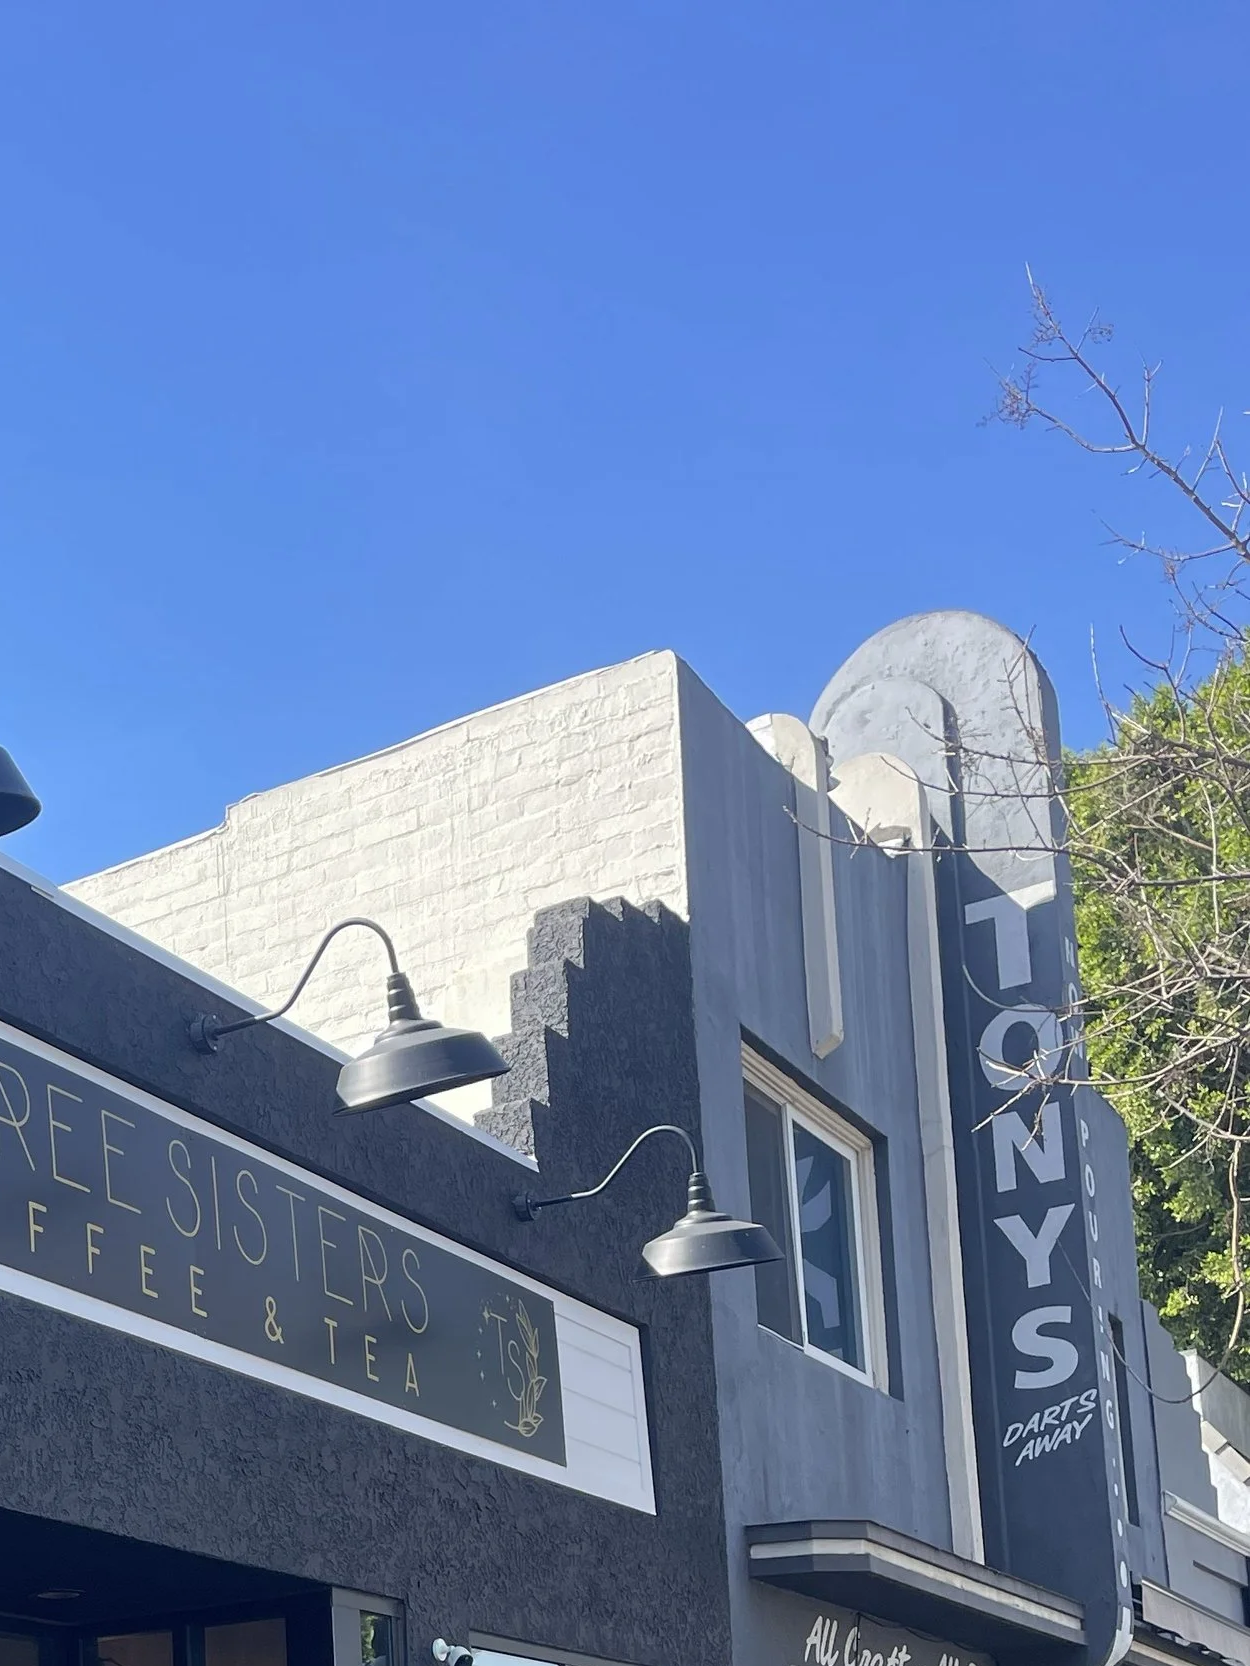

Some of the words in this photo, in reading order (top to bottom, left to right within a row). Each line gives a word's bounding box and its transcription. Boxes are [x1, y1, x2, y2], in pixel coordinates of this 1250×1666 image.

[964, 896, 1080, 1390] TONYS
[166, 1139, 430, 1334] SISTERS
[1080, 1119, 1115, 1429] POURING
[264, 1296, 285, 1344] &
[324, 1317, 421, 1398] TEA
[489, 1312, 526, 1401] TS
[1003, 1388, 1098, 1448] DARTS
[1014, 1413, 1093, 1467] AWAY
